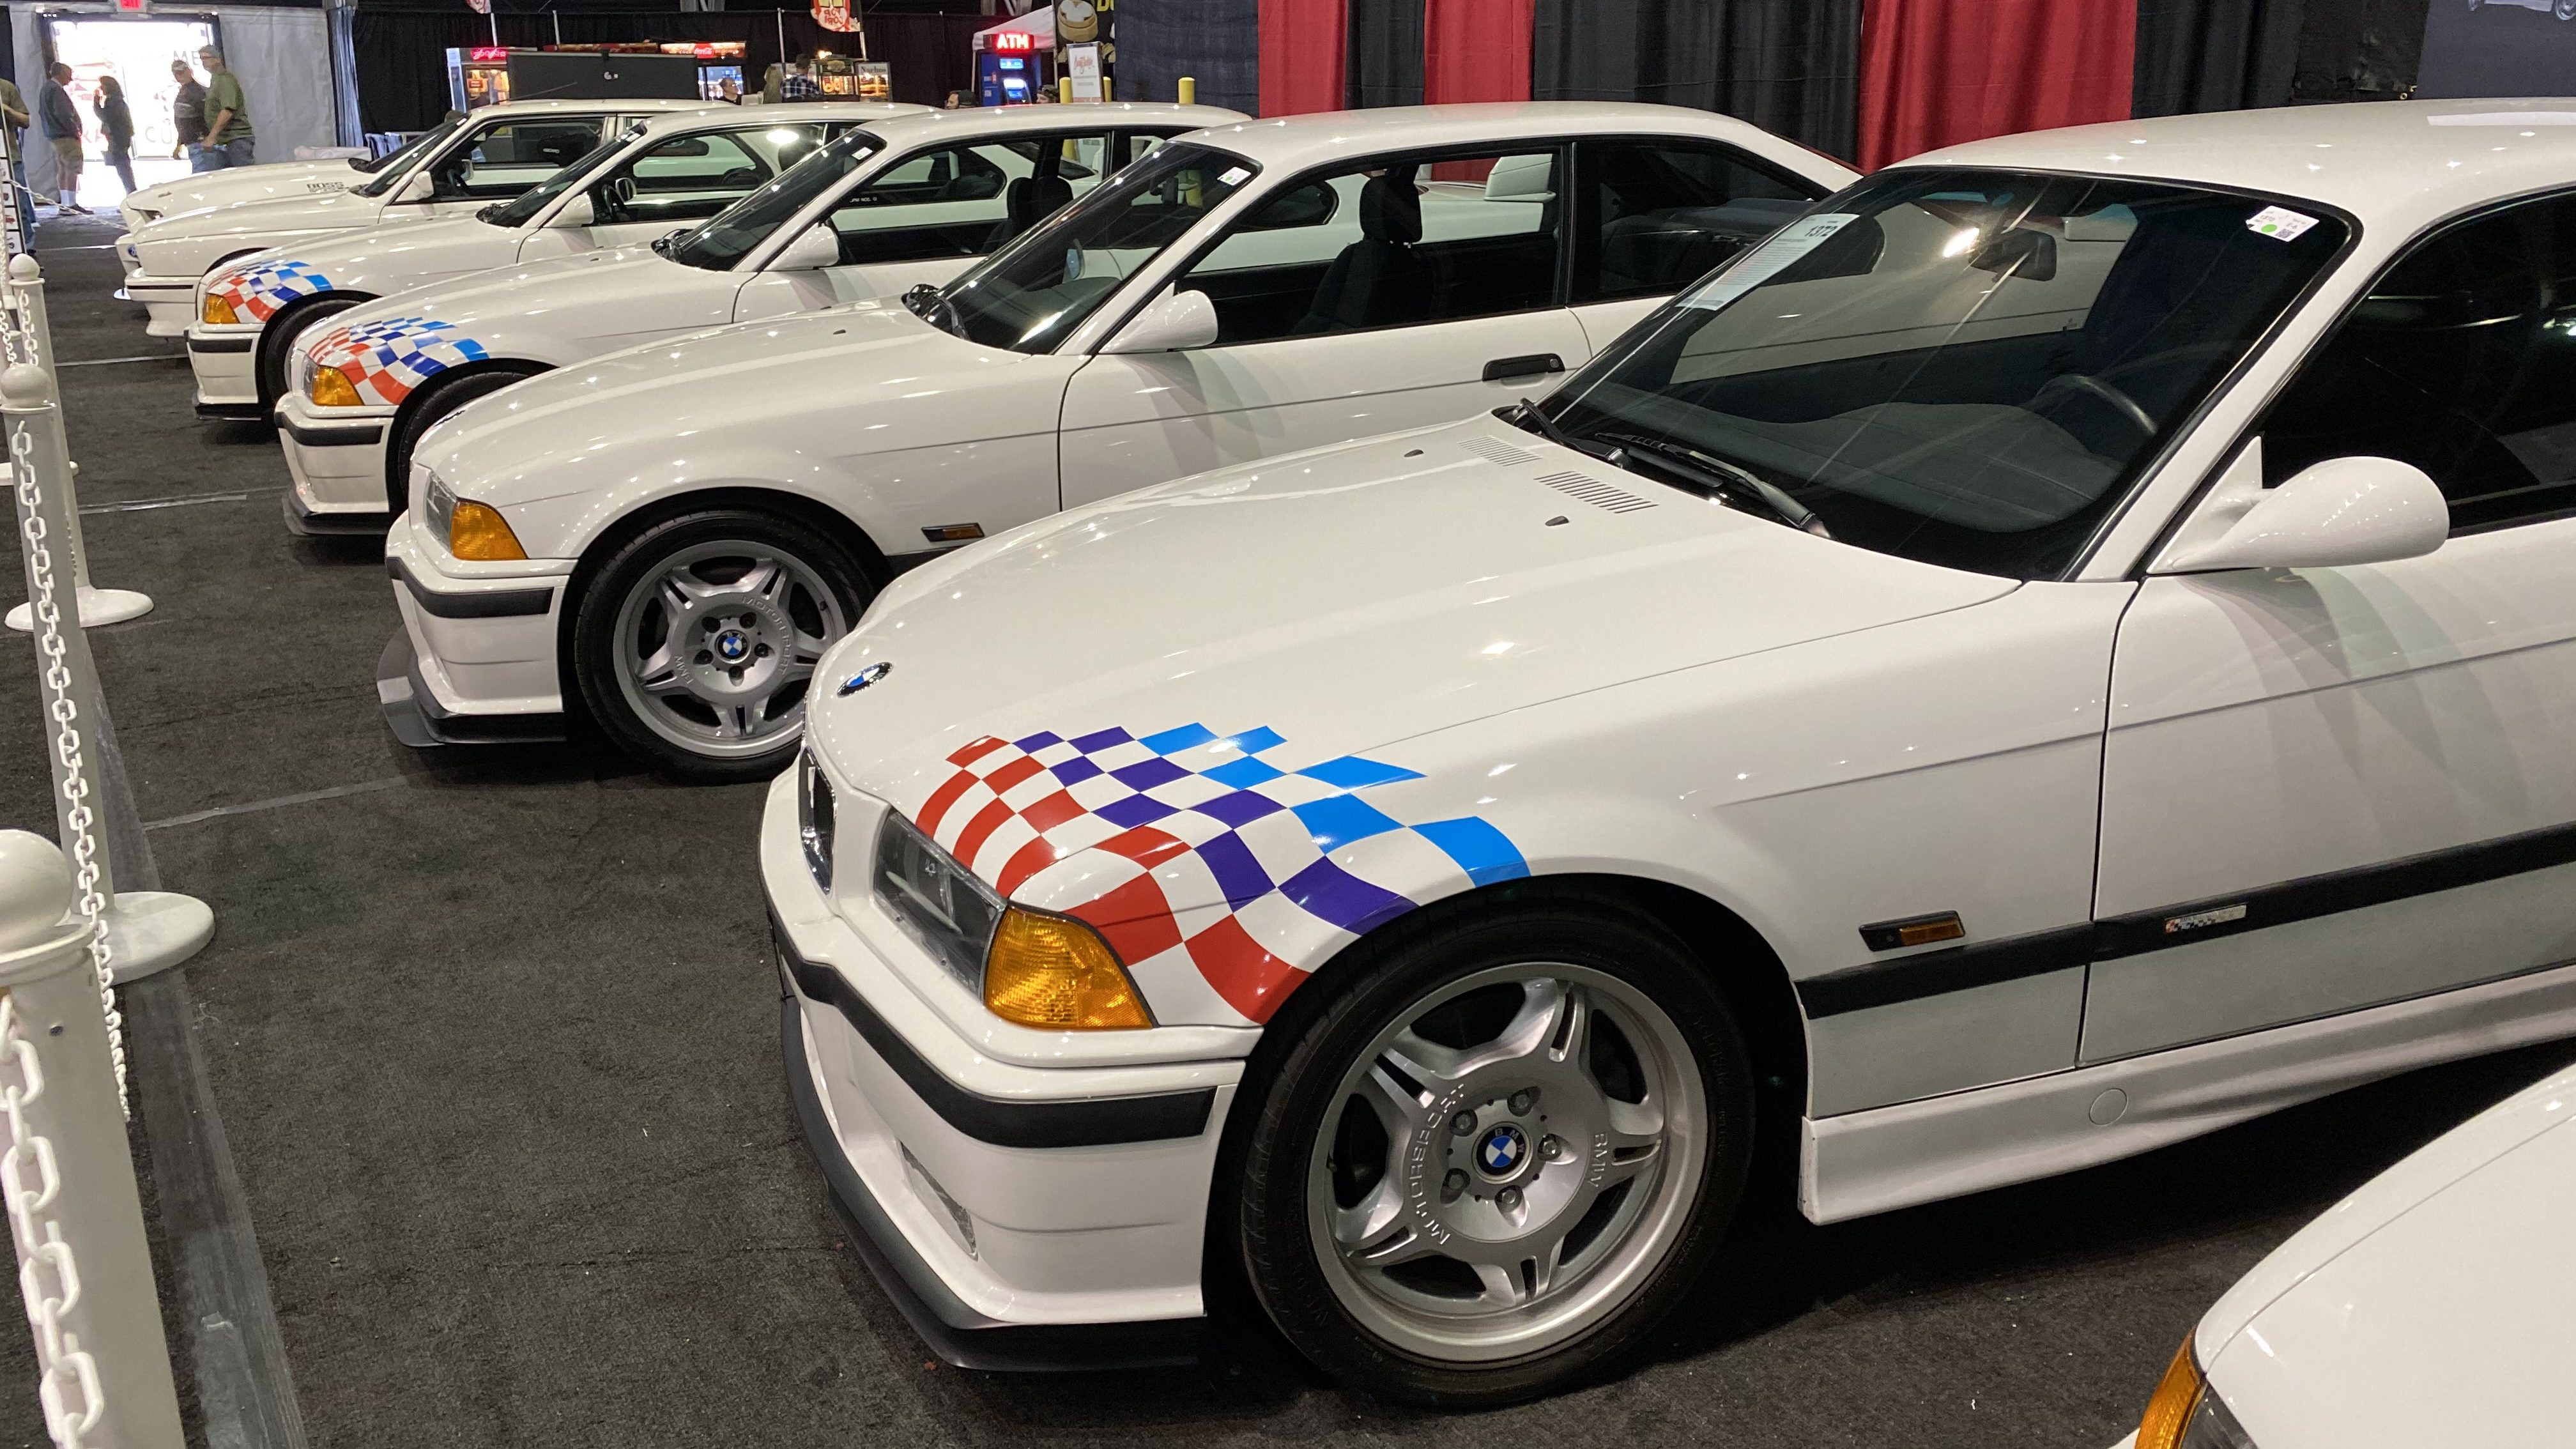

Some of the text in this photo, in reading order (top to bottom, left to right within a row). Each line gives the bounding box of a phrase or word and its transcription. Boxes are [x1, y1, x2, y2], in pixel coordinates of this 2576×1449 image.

[997, 33, 1029, 49] ATM
[1804, 225, 1839, 237] 1372
[1494, 1129, 1525, 1153] BMW
[1408, 1084, 1465, 1246] MOTORSPORT
[1588, 1133, 1609, 1188] BMW
